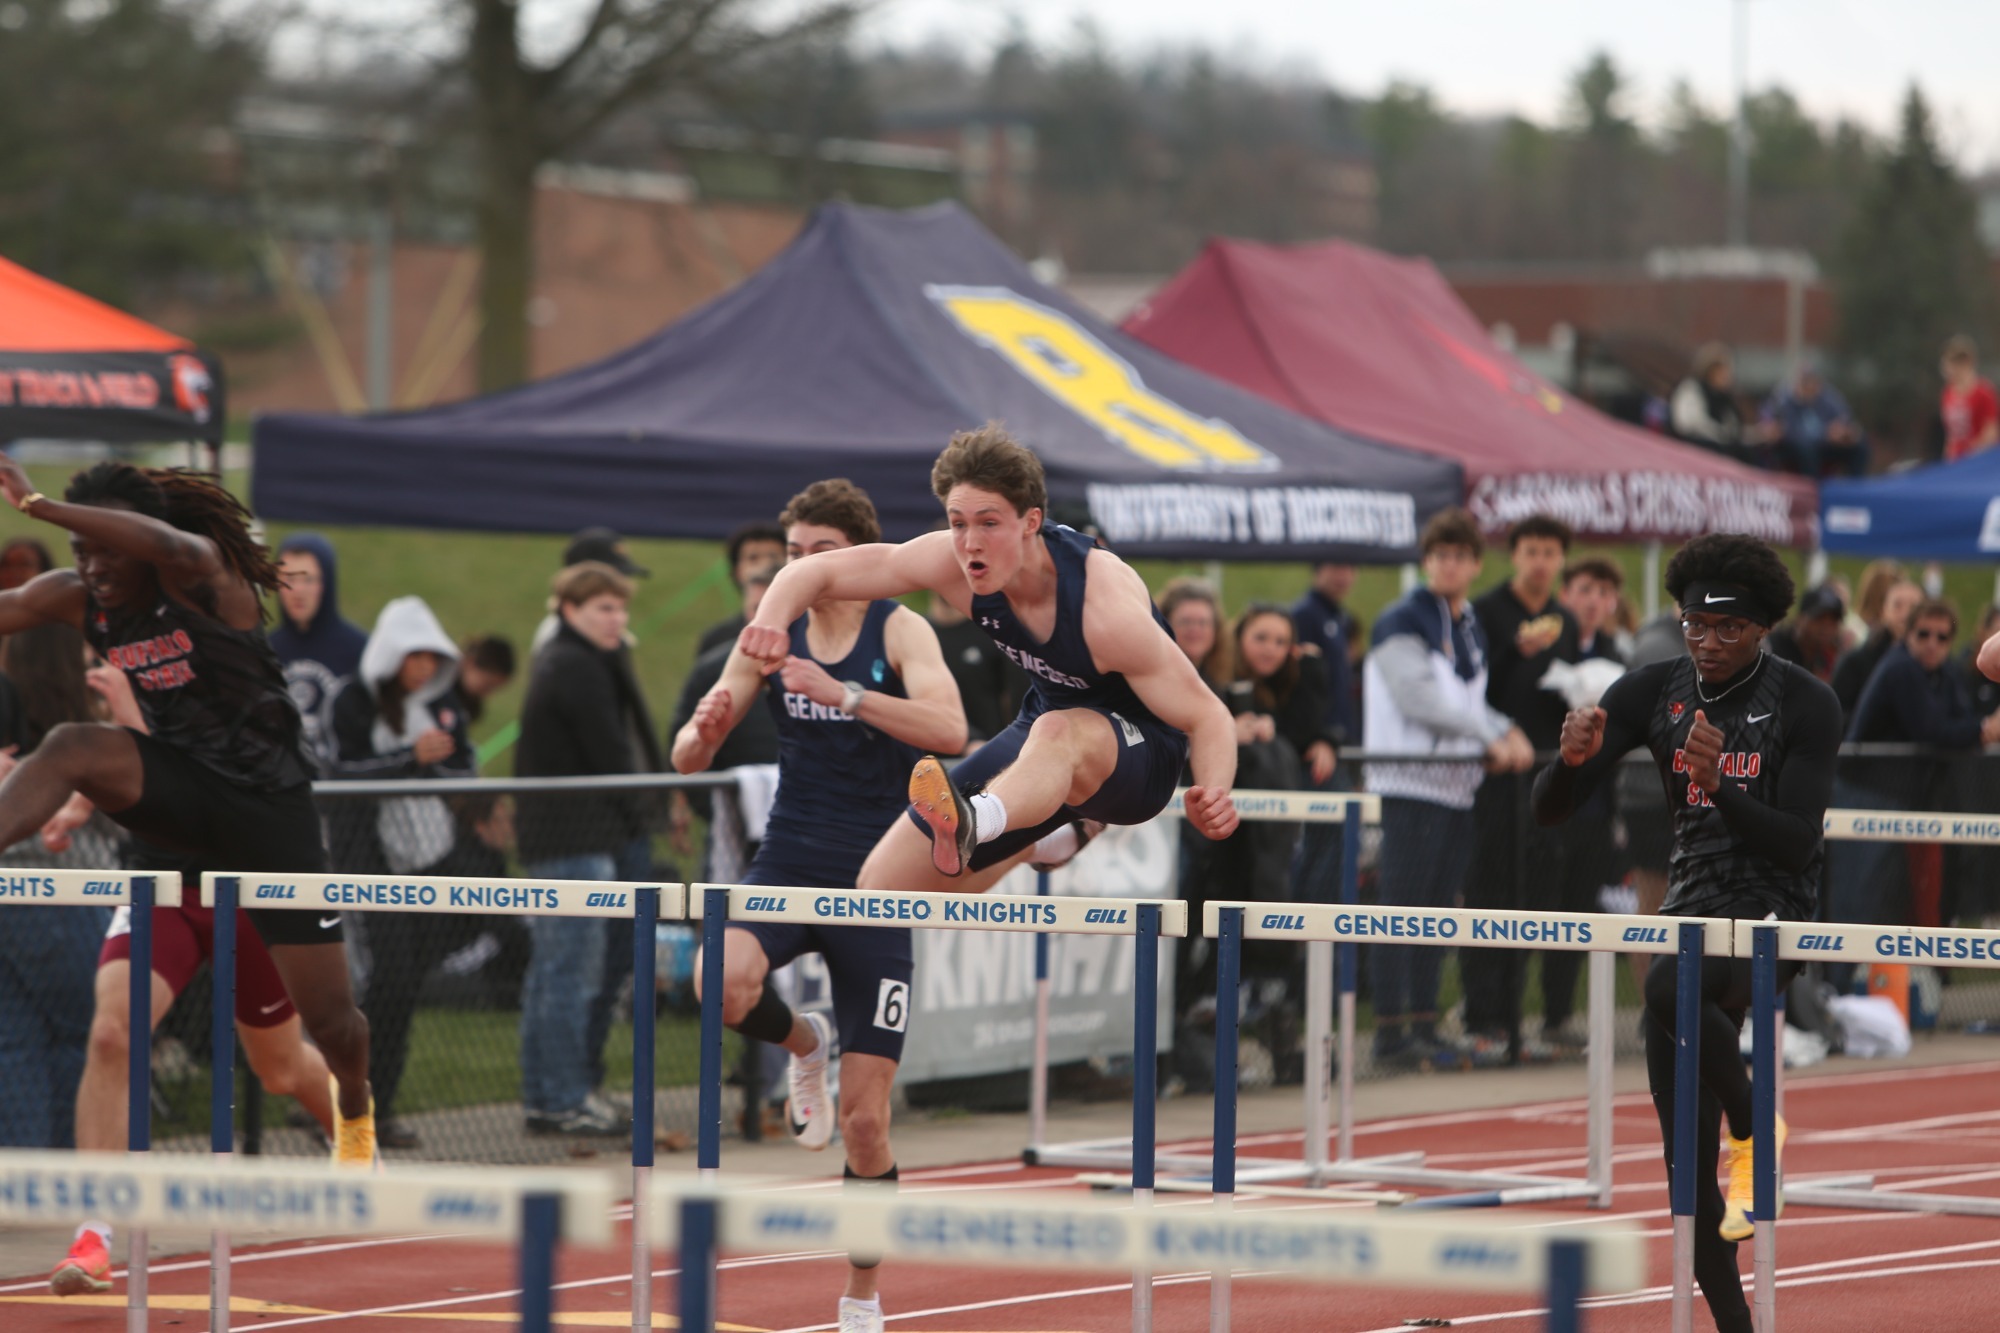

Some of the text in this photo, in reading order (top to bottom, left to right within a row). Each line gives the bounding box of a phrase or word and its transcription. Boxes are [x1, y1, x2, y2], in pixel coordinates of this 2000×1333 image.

[923, 283, 1282, 472] R
[1086, 483, 1416, 547] UNIVERSITY OF ROCHESTER
[107, 629, 193, 670] BUFFALO
[783, 692, 857, 721] GENE
[1852, 817, 1943, 836] GENESEO
[83, 881, 124, 895] GILL
[255, 883, 627, 909] GILL GENESEO KNIGHTS GILL
[745, 895, 1128, 925] GILL GENESEO KNIGHTS GILL
[1261, 913, 1668, 943] GILL GENESEO KNIGHTS GILL
[1797, 934, 1844, 951] GILL
[884, 985, 903, 1028] 6
